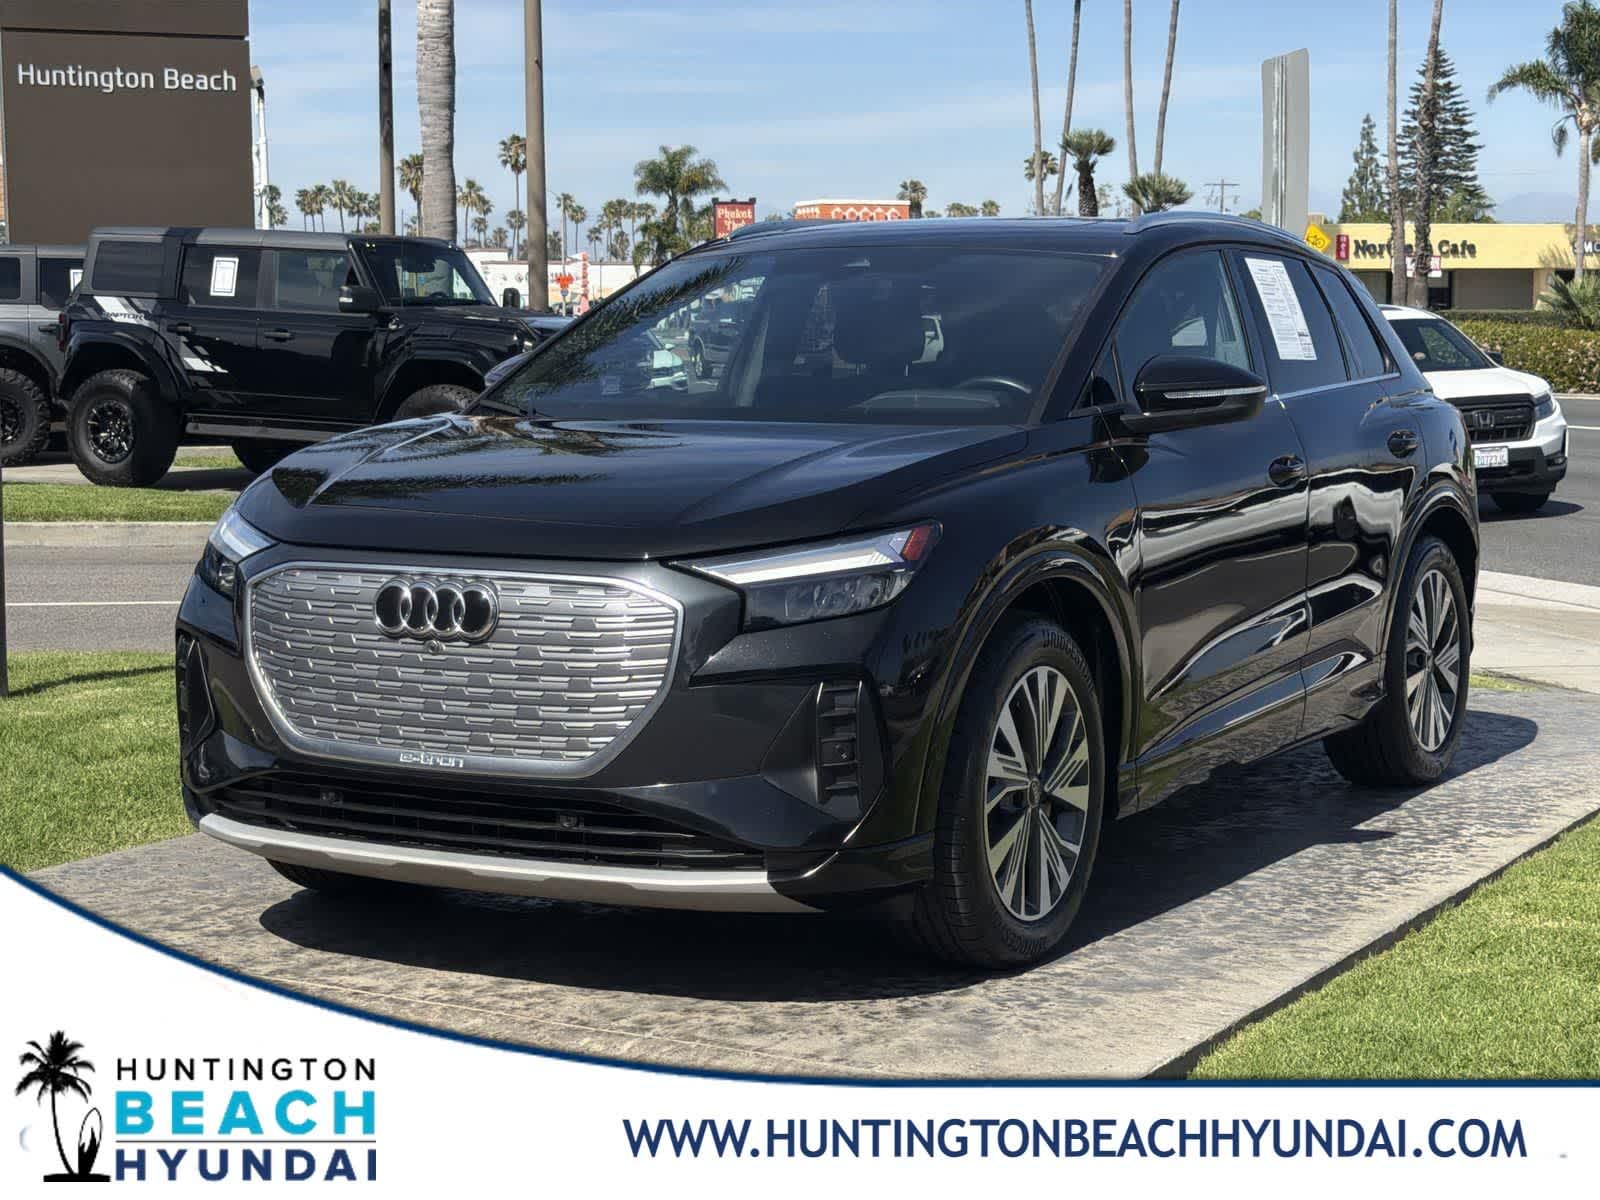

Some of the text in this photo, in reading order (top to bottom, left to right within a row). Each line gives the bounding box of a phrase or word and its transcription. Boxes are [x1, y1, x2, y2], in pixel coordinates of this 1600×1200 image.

[17, 63, 237, 93] Huntington Beach
[1438, 239, 1477, 258] Cafe
[400, 752, 463, 768] e-tron
